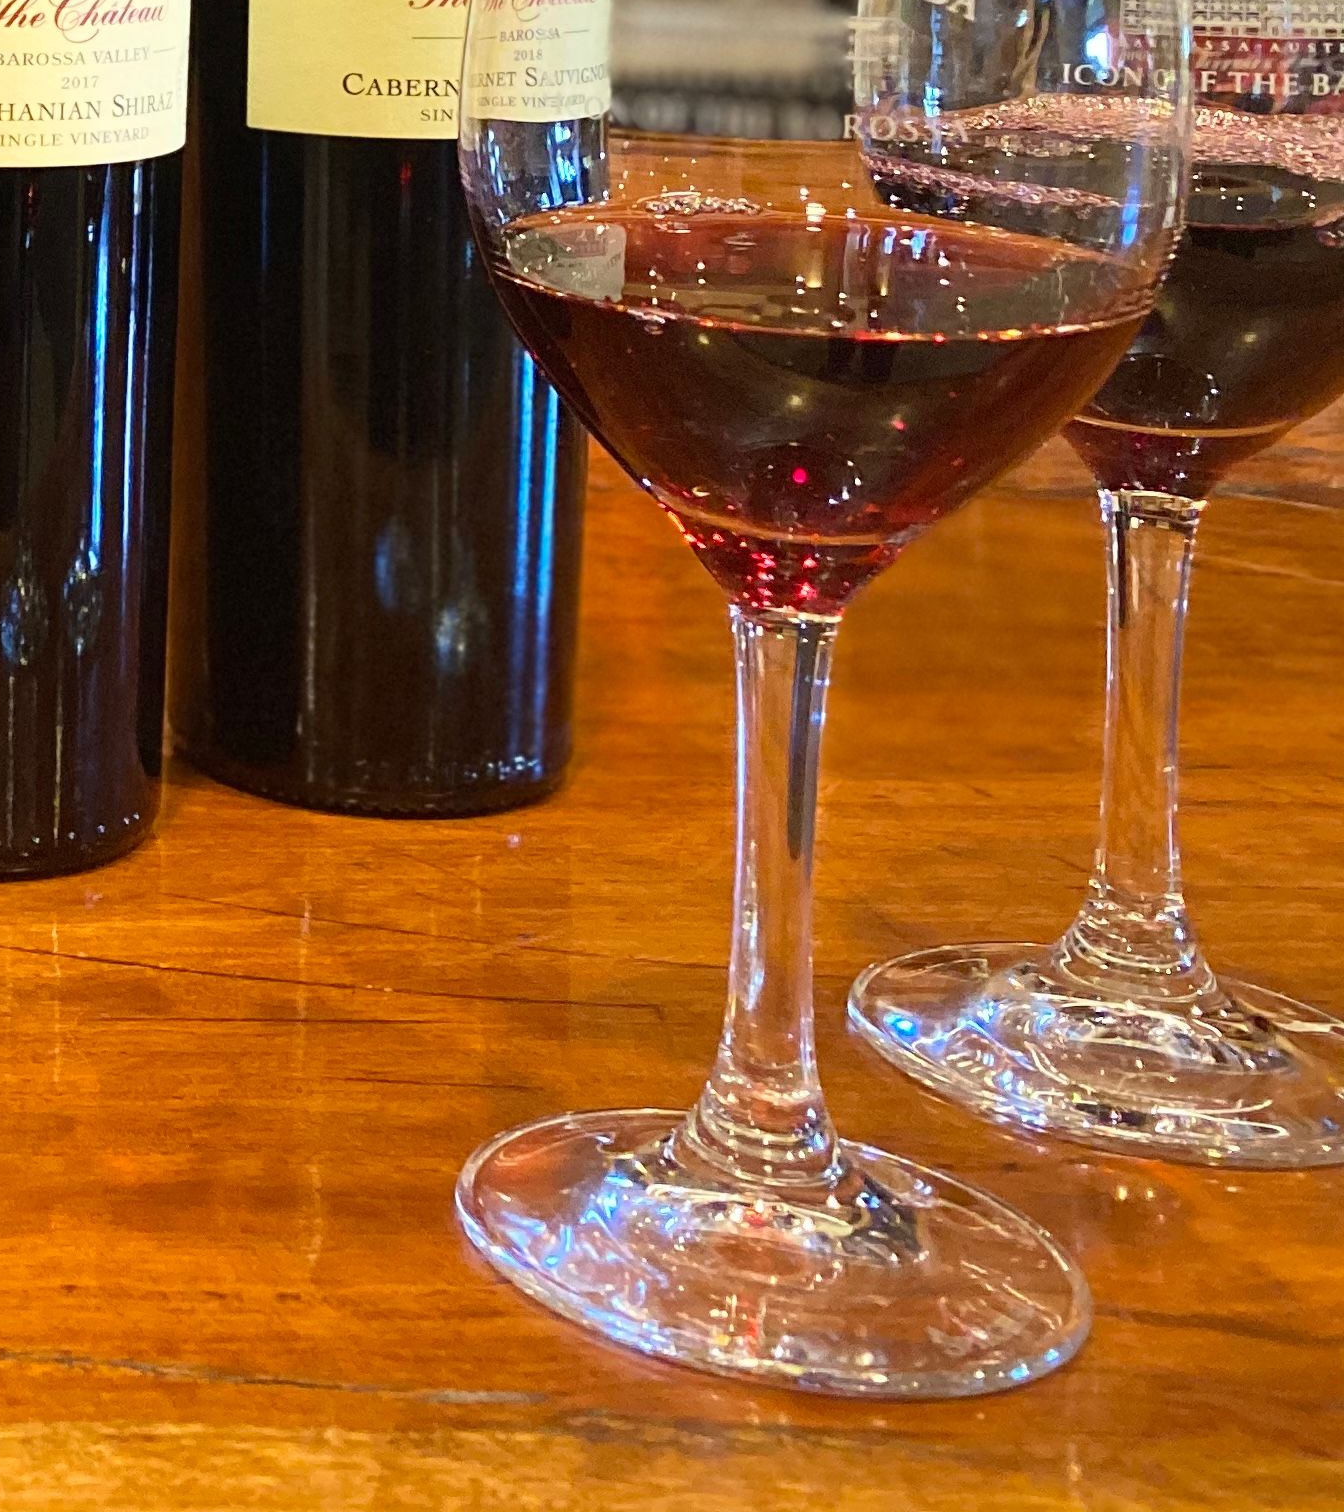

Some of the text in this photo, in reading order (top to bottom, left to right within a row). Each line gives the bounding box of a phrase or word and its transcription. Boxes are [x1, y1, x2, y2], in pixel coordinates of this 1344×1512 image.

[92, 46, 151, 66] VALLEY
[61, 74, 101, 91] 2017
[1227, 71, 1300, 96] THE
[111, 91, 175, 119] SHIRAZ
[70, 126, 150, 147] VINEYARD
